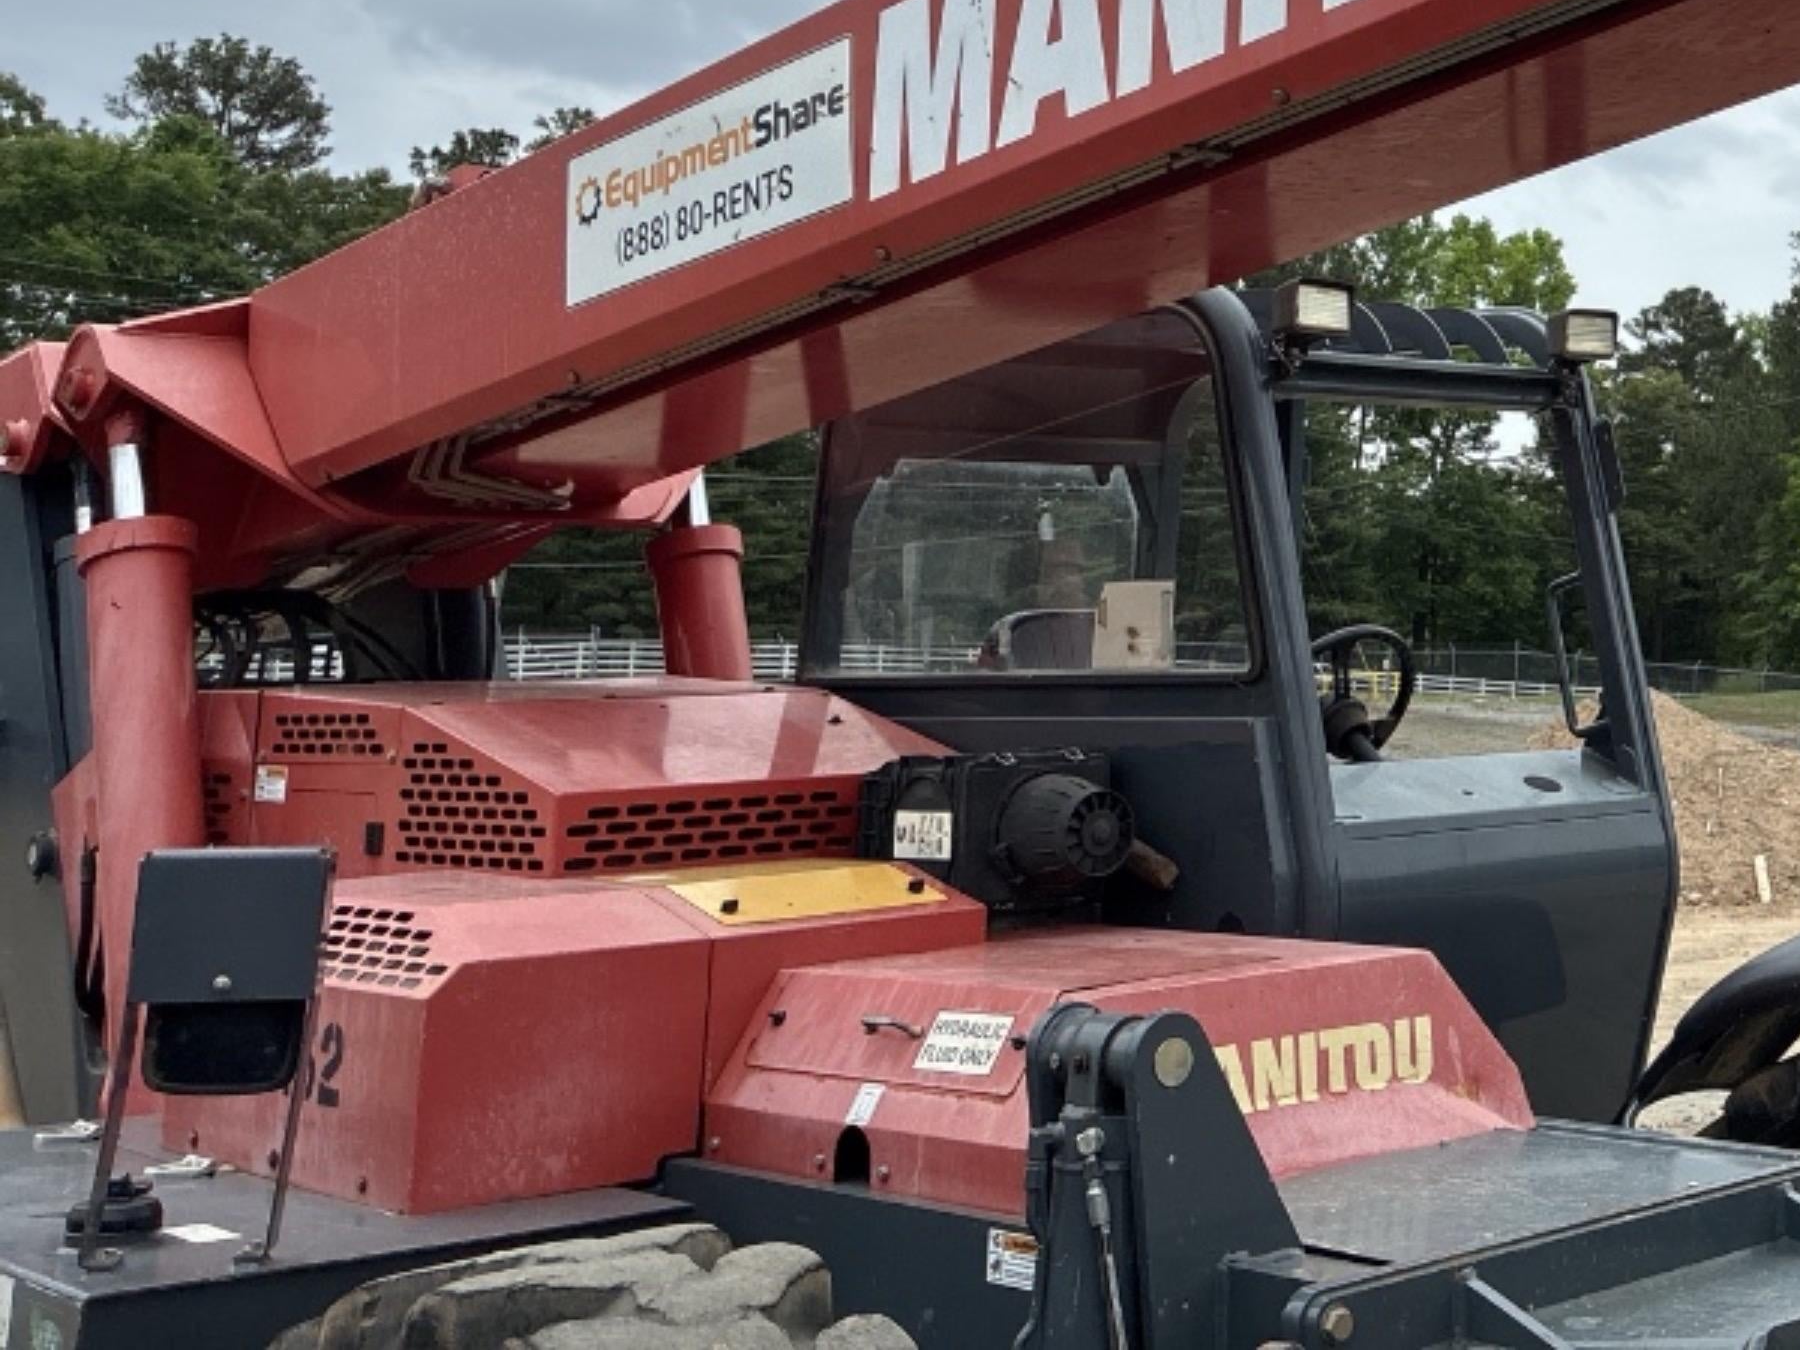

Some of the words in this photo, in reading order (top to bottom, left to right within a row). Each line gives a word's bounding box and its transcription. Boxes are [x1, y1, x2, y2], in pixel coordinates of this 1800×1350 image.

[604, 83, 844, 209] EquipmentShare
[617, 210, 671, 267] (888)
[676, 164, 793, 242] 80-RENTS
